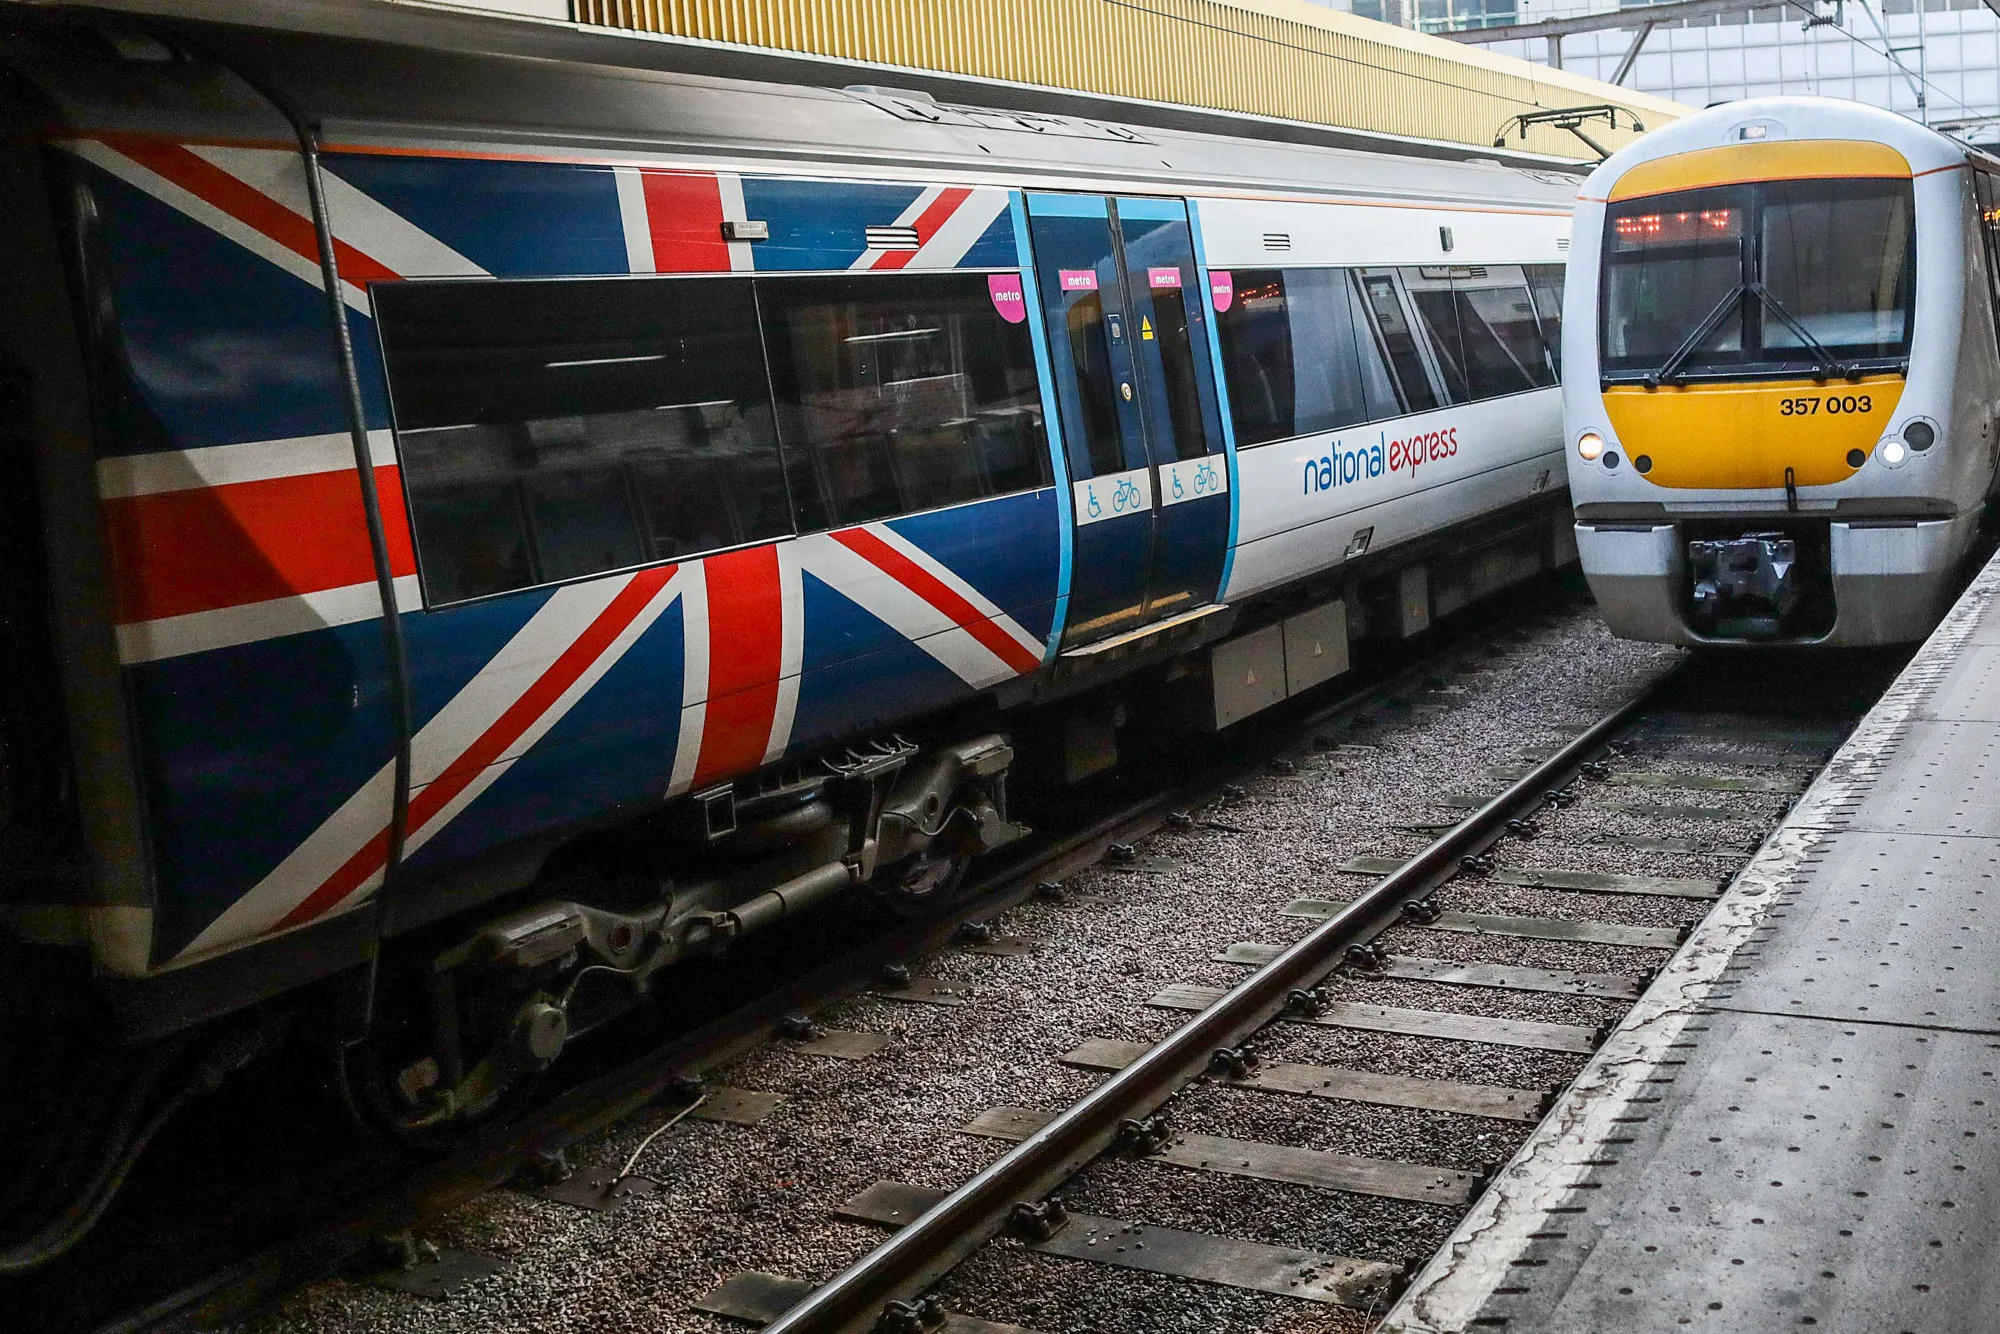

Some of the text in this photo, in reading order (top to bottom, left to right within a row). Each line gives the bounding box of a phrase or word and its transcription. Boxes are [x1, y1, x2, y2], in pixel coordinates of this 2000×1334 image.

[1067, 276, 1091, 286] metro
[1155, 275, 1176, 284] metro
[1213, 285, 1231, 294] metro
[995, 291, 1020, 302] metro
[1780, 395, 1872, 416] 357 003
[1304, 427, 1458, 495] national express
